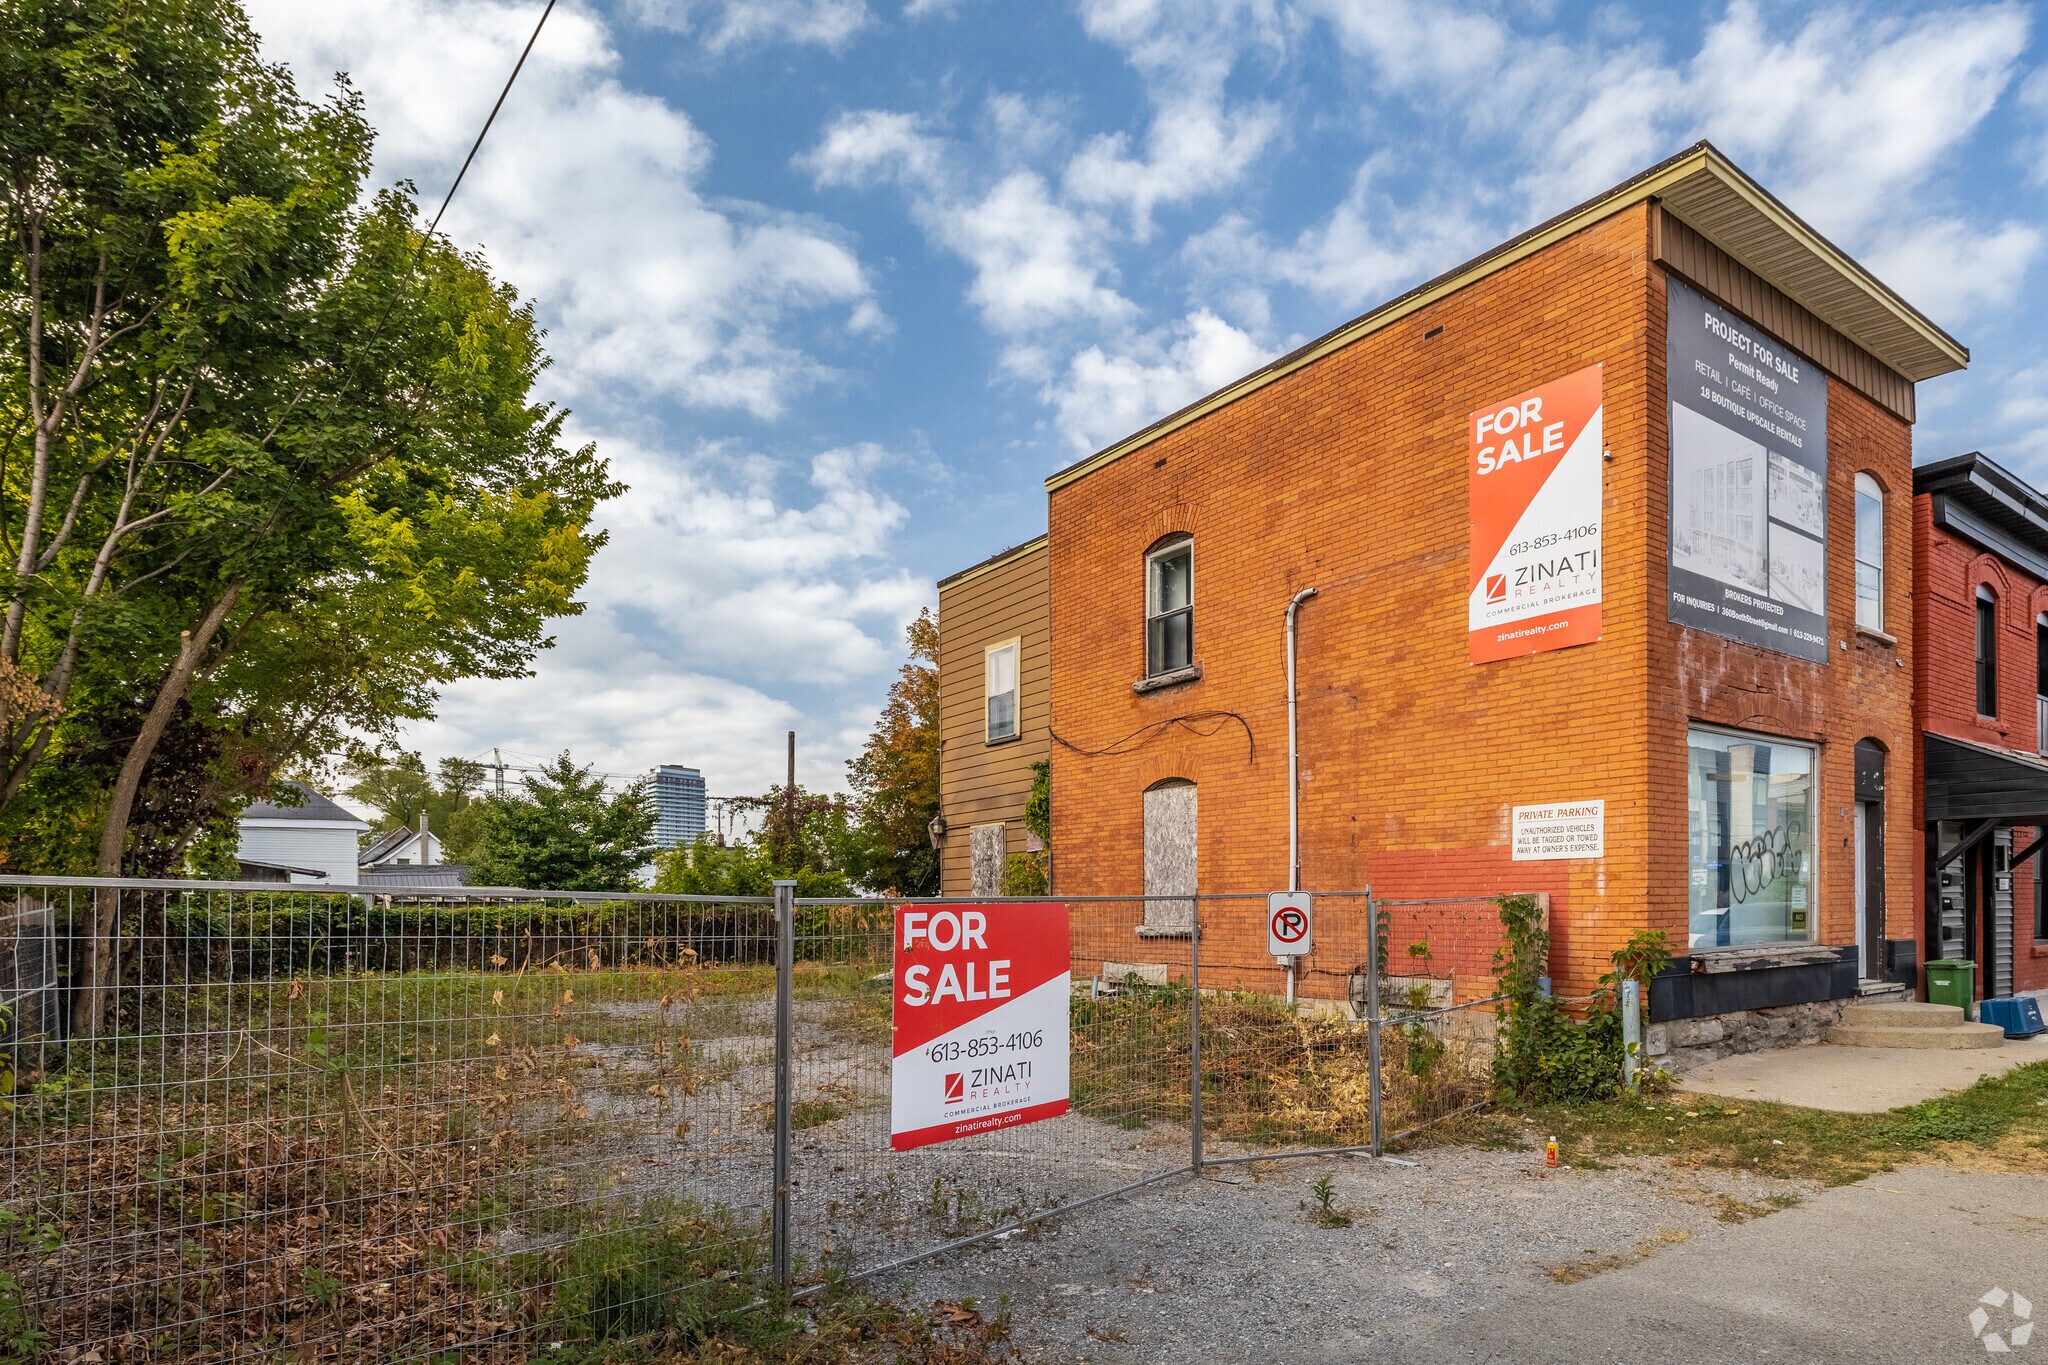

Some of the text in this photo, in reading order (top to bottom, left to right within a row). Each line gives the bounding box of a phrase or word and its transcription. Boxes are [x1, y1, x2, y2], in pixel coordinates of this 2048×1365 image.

[1704, 312, 1798, 384] PROJECT FOR SALE
[1729, 353, 1778, 394] Permit Ready
[1695, 360, 1722, 384] RETAIL
[1732, 381, 1750, 400] CAFÉ
[1759, 396, 1784, 419] OFFICE
[1784, 410, 1806, 431] SPACE
[1476, 397, 1543, 444] FOR
[1700, 386, 1802, 448] 18 BOUTIQUE UPSCALE RENTALS
[1476, 421, 1564, 476] SALE
[1510, 523, 1598, 556] 613-853-4106
[1515, 550, 1597, 586] ZINATI
[1514, 571, 1597, 598] REALTY
[1486, 588, 1597, 618] COMMERCIAL BROKERAGE
[1673, 592, 1685, 604] FOR
[1686, 596, 1715, 612] INQUIRIES
[1725, 588, 1784, 616] BROKERS PROTECTED
[1497, 620, 1568, 642] zinatirealty.com
[1518, 806, 1598, 820] PRIVATE PARKING
[1521, 824, 1594, 835] UNAUTHORIZED VEHICLES
[1542, 836, 1564, 844] TAGGED
[1542, 845, 1568, 853] OWNER'S
[904, 911, 988, 952] FOR
[1283, 914, 1302, 936] P
[903, 960, 1011, 1007] SALE
[931, 1030, 1042, 1062] 613-853-4106
[971, 1061, 1032, 1088] ZINATI
[970, 1081, 1031, 1100] REALTY
[944, 1096, 1031, 1118] COMMERCIAL BROKERAGE
[955, 1112, 1022, 1134] zinatirealty.com
